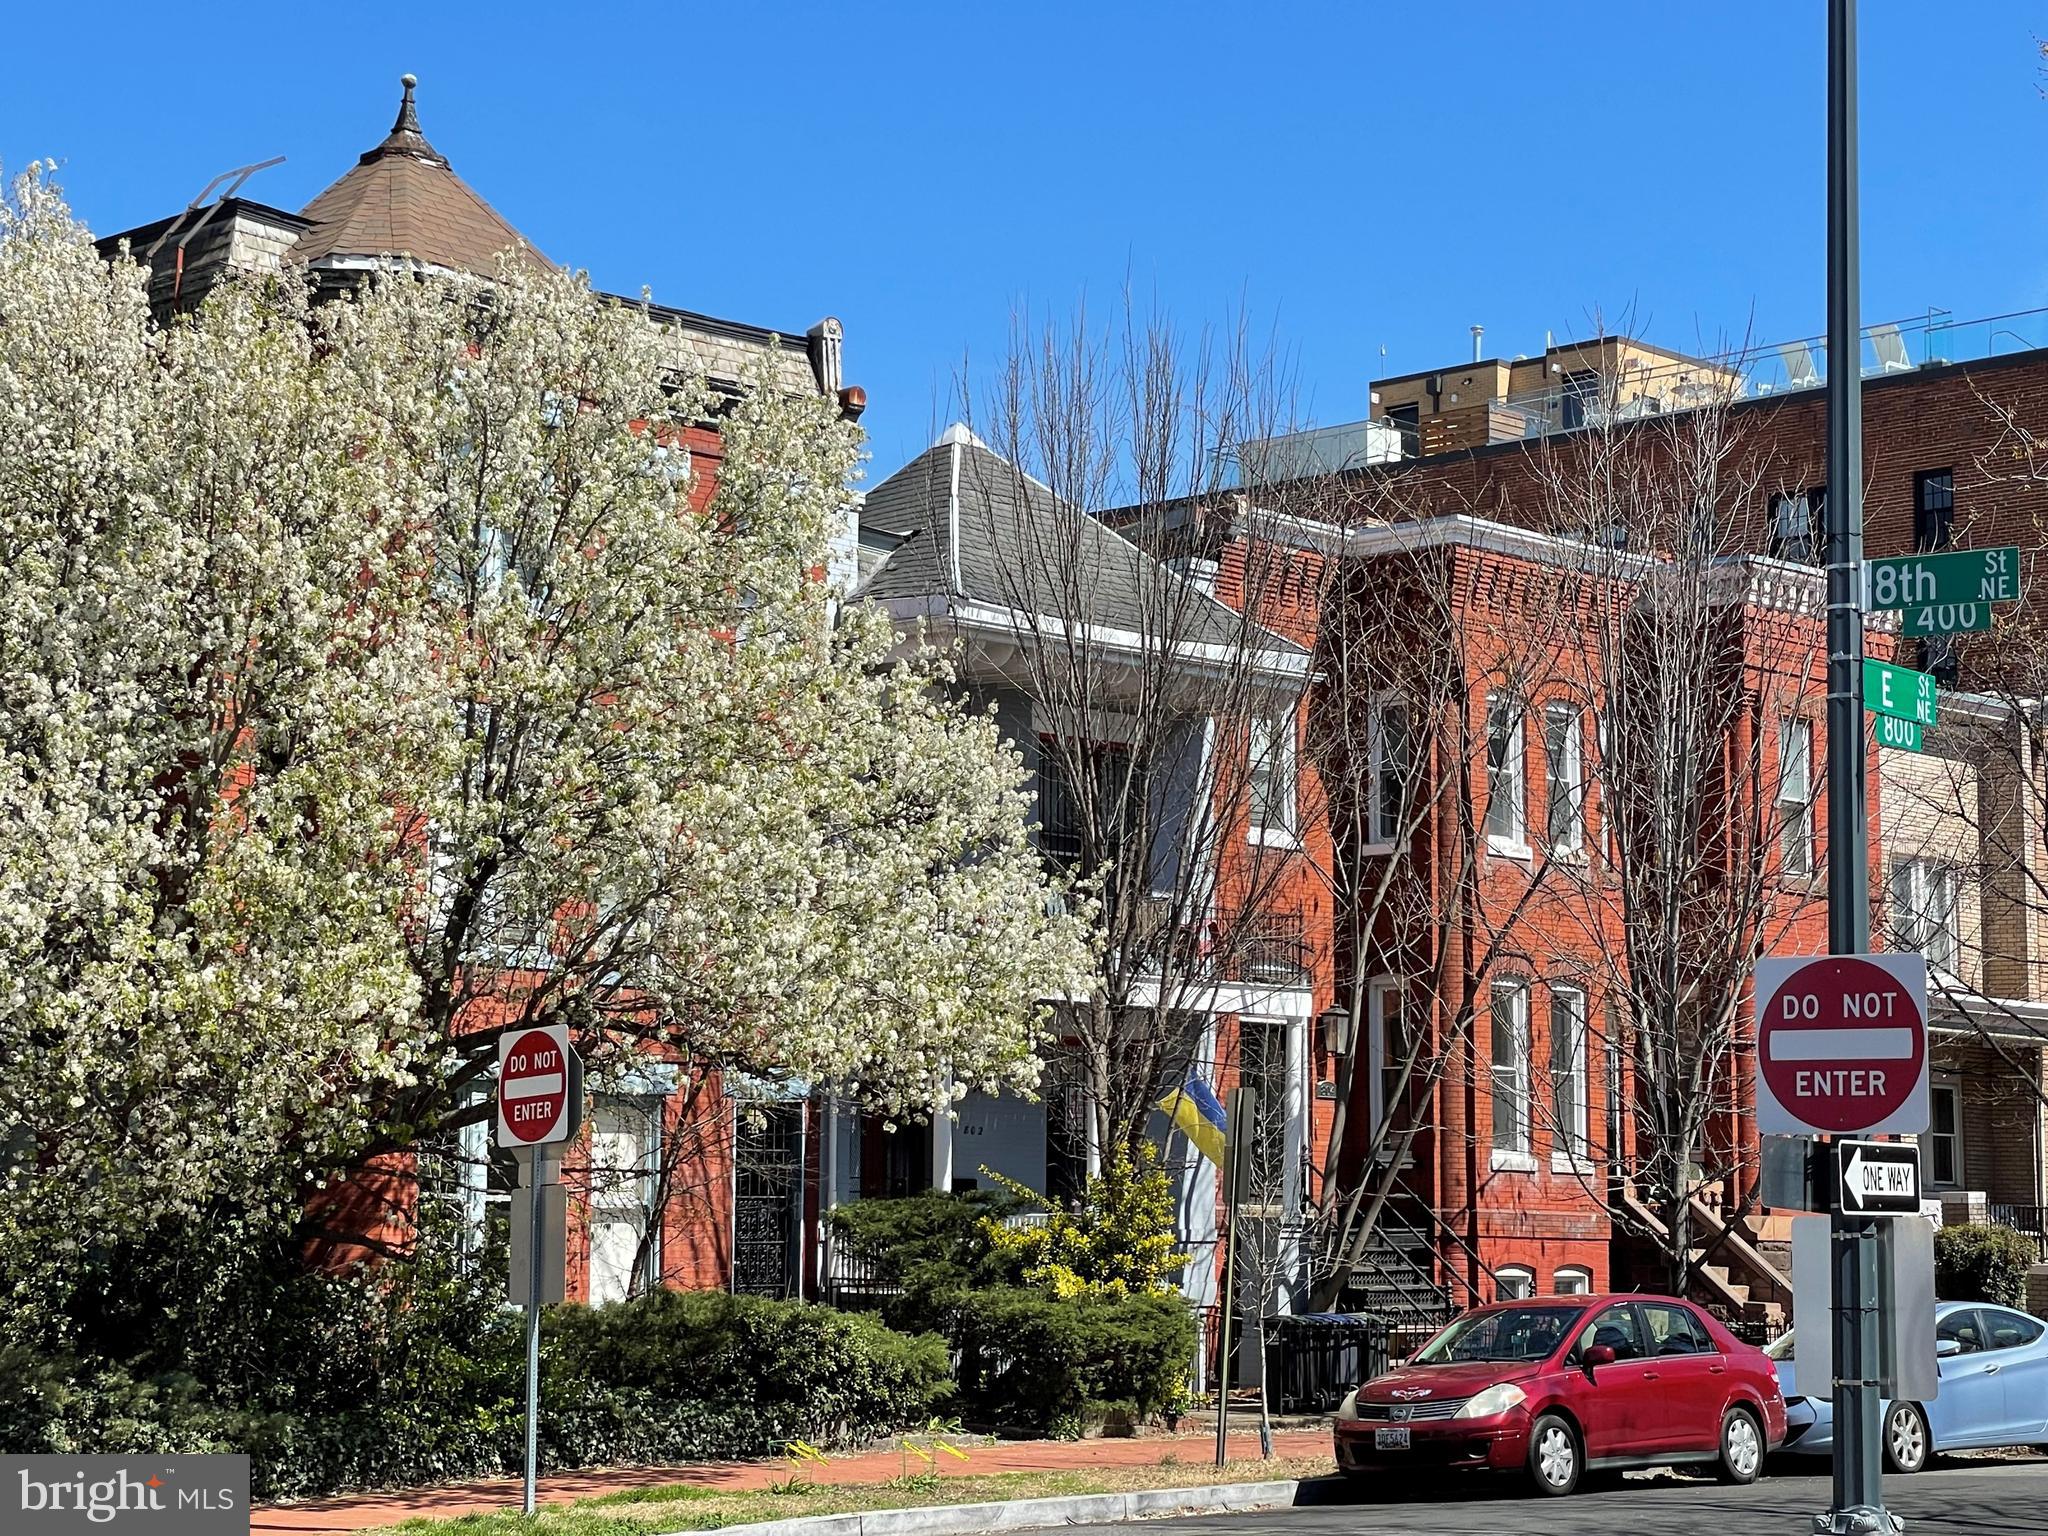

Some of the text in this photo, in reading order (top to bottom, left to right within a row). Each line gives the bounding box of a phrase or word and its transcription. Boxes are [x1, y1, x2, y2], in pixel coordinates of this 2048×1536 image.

[1875, 551, 2007, 605] 8th St
[1981, 576, 2011, 600] NE
[1917, 603, 1977, 632] 400
[1881, 670, 1930, 708] E St
[1916, 700, 1933, 724] NE
[1883, 716, 1914, 747] 800
[1782, 992, 1897, 1020] DO NOT
[510, 1050, 557, 1073] DO NOT
[1795, 1070, 1887, 1097] ENTER
[514, 1101, 552, 1122] ENTER
[1862, 1165, 1911, 1192] ONE WAY
